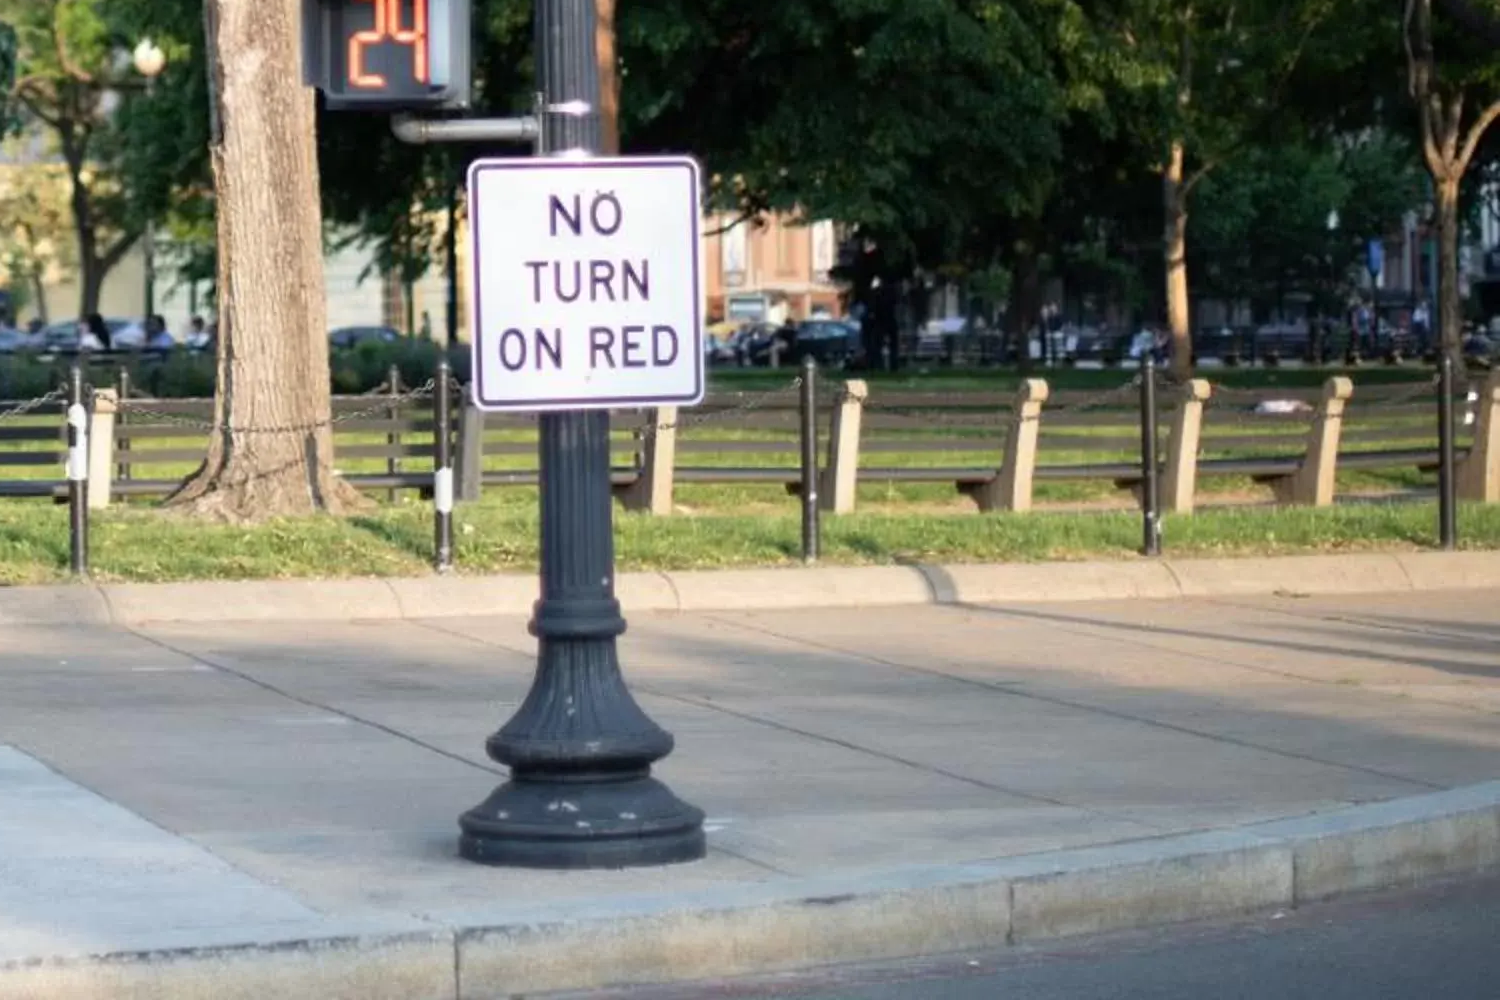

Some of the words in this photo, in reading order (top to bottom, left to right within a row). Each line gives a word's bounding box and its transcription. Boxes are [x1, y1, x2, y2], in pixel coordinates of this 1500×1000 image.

[549, 192, 622, 236] NO
[525, 259, 649, 303] TURN
[499, 327, 562, 372] ON
[589, 325, 679, 368] RED
